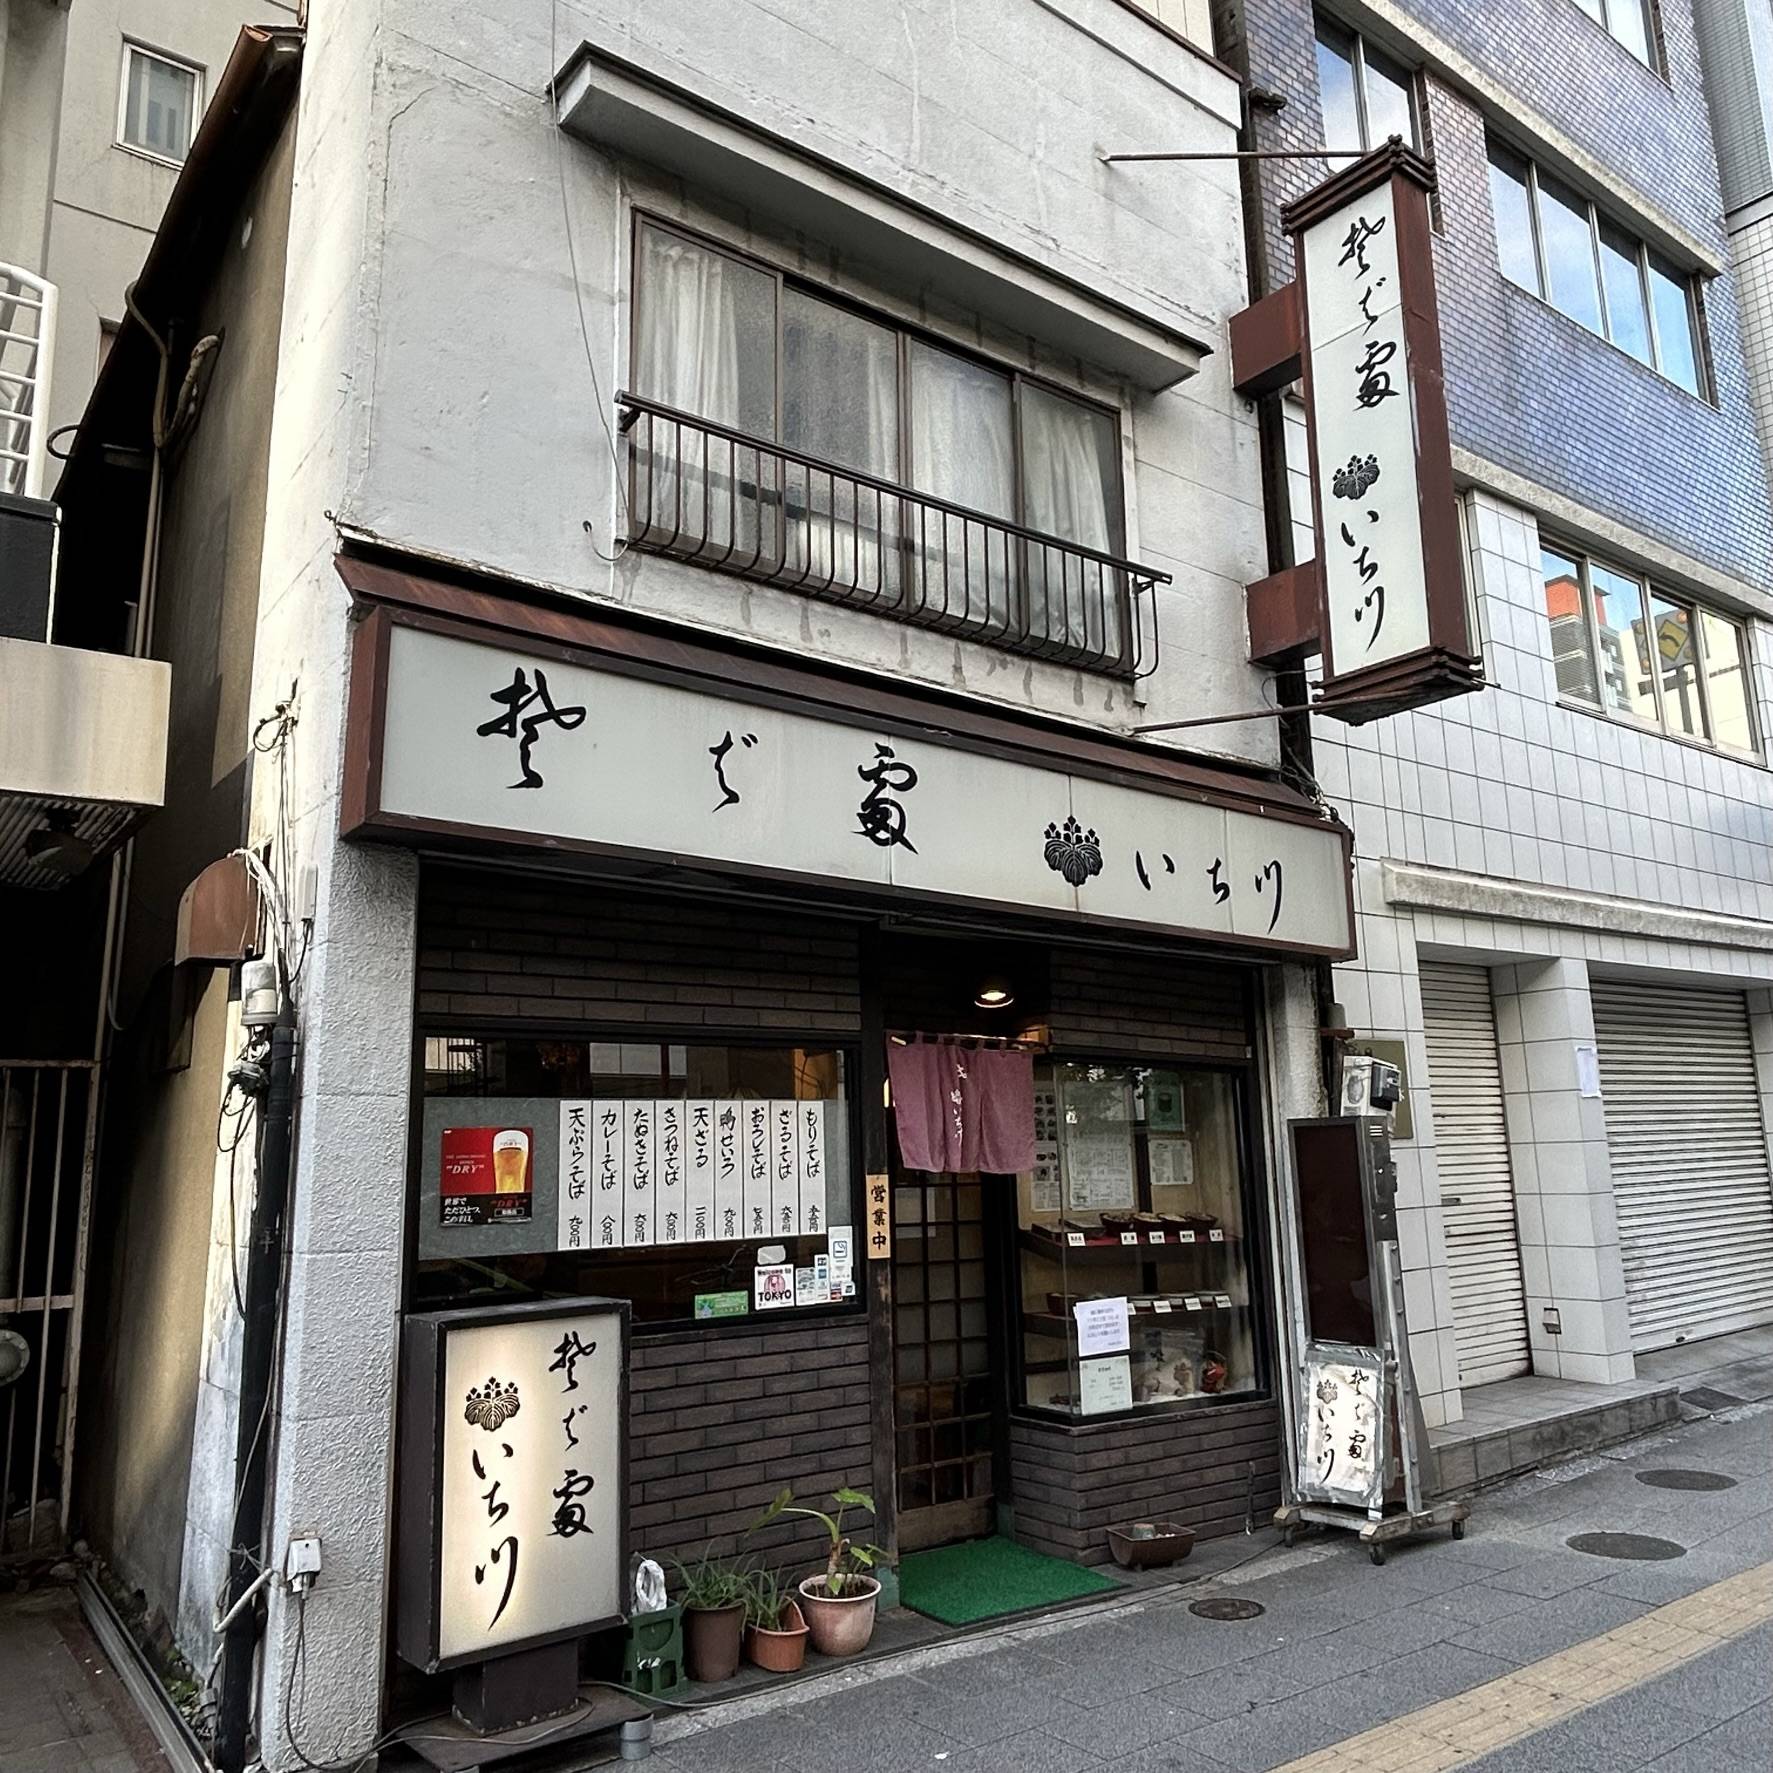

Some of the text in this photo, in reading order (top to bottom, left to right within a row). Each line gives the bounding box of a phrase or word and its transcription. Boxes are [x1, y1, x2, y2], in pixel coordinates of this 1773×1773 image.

[1341, 510, 1384, 651] いち川
[1136, 850, 1282, 934] いち川
[601, 1108, 617, 1190] カレーそば
[633, 1108, 650, 1190] たぬきそば
[664, 1107, 680, 1186] きつねそば
[692, 1107, 709, 1168] 天ざる
[750, 1107, 767, 1180] おろしそば
[778, 1109, 793, 1180] ざるそば
[806, 1108, 821, 1178] もりそば
[870, 1184, 887, 1250] 営業中
[757, 1289, 792, 1302] TOKYO
[1316, 1407, 1335, 1484] いち川
[472, 1443, 519, 1631] いち川
